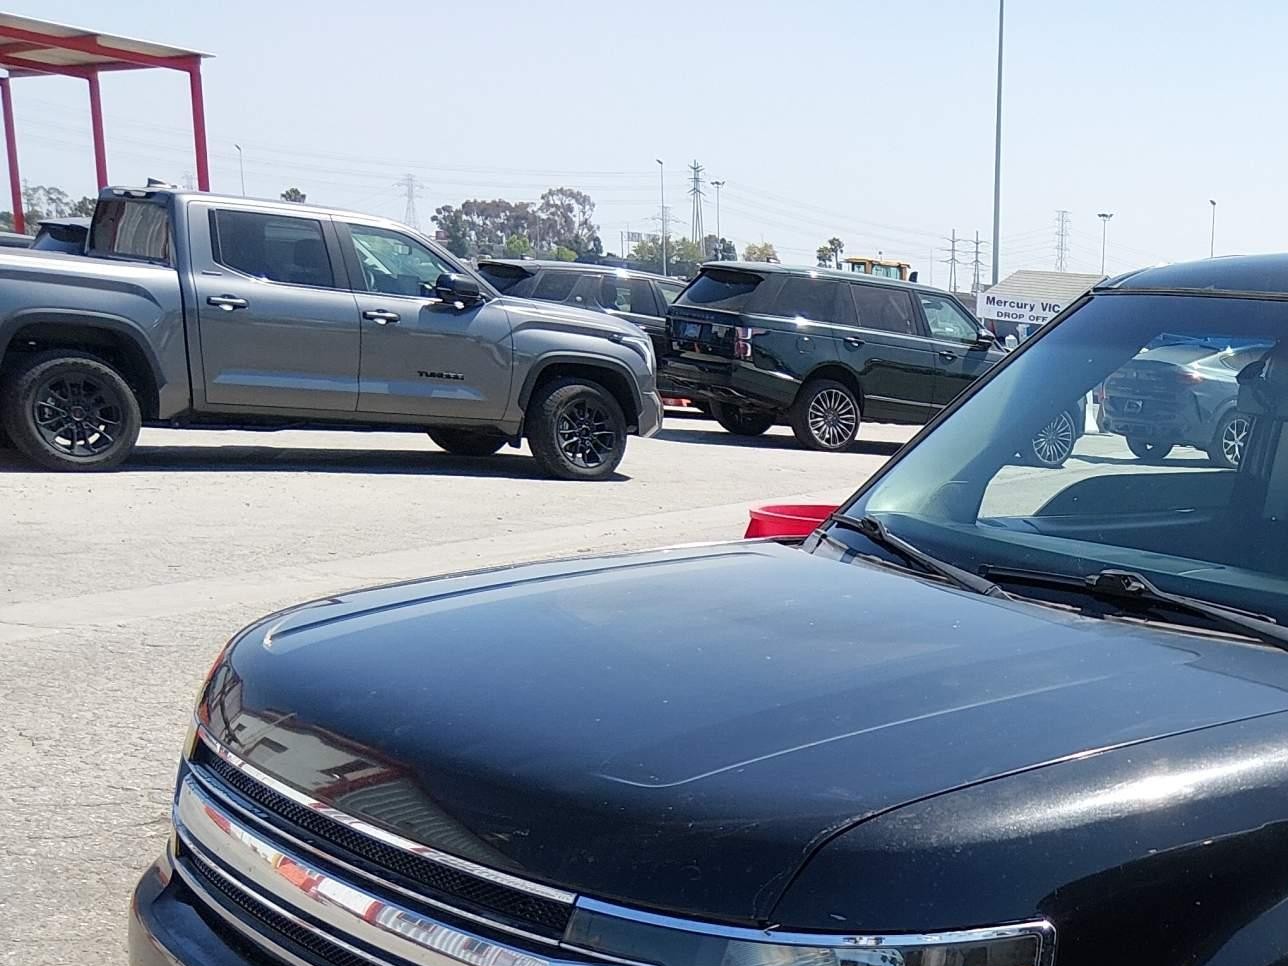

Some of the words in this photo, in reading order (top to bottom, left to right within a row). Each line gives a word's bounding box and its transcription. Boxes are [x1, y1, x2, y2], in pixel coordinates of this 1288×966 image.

[986, 296, 1035, 312] Mercury
[1041, 302, 1061, 313] VIC
[996, 311, 1025, 319] DROP
